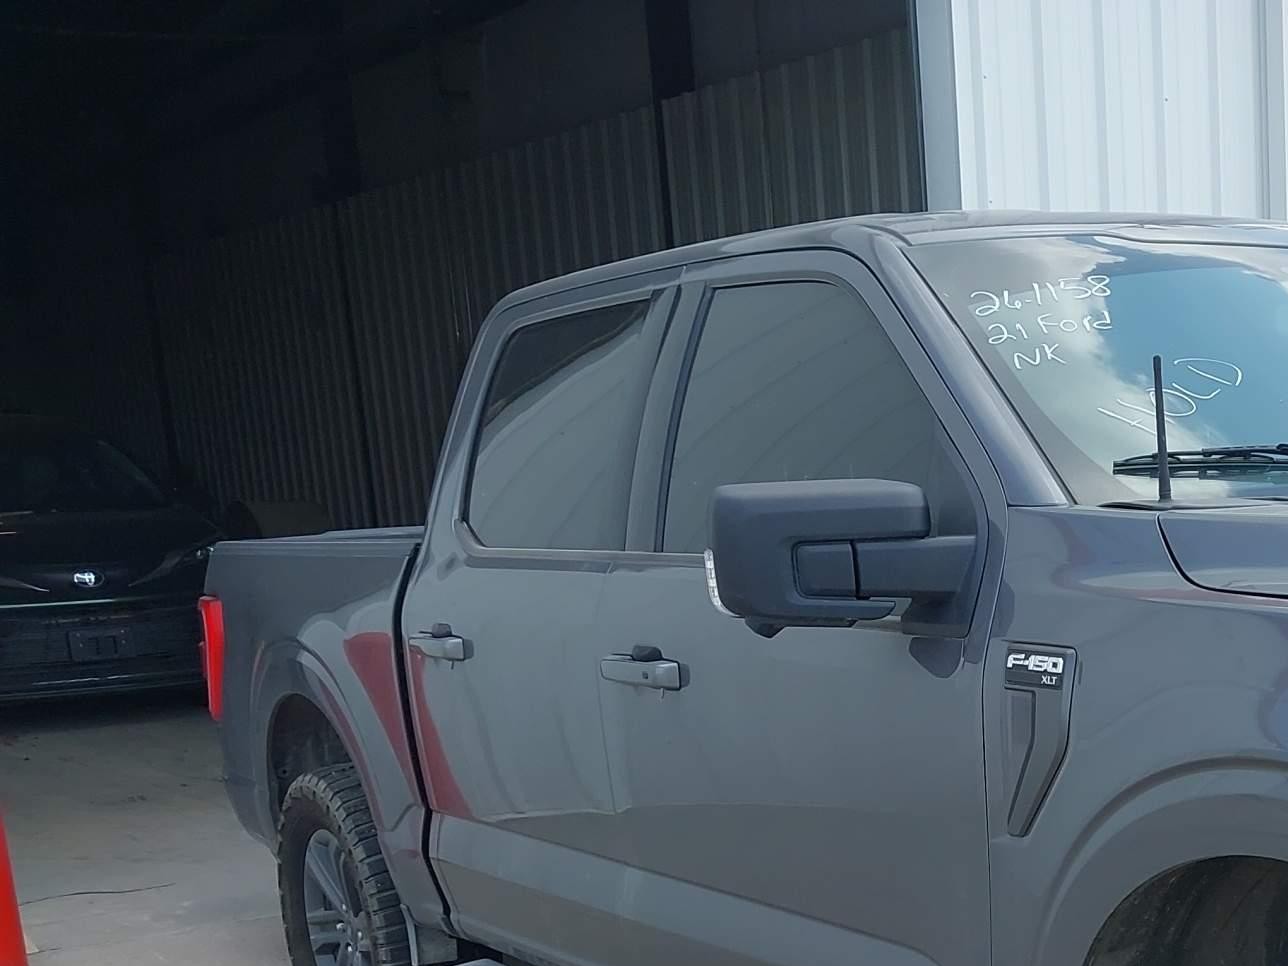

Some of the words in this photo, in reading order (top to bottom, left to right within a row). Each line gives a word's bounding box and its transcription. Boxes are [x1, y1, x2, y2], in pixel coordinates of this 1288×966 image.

[970, 275, 1112, 316] 26-1158
[988, 323, 1028, 345] 21
[1037, 311, 1112, 336] Ford
[1013, 343, 1066, 370] NK
[1007, 653, 1063, 674] F-150
[1041, 675, 1057, 684] XLT
